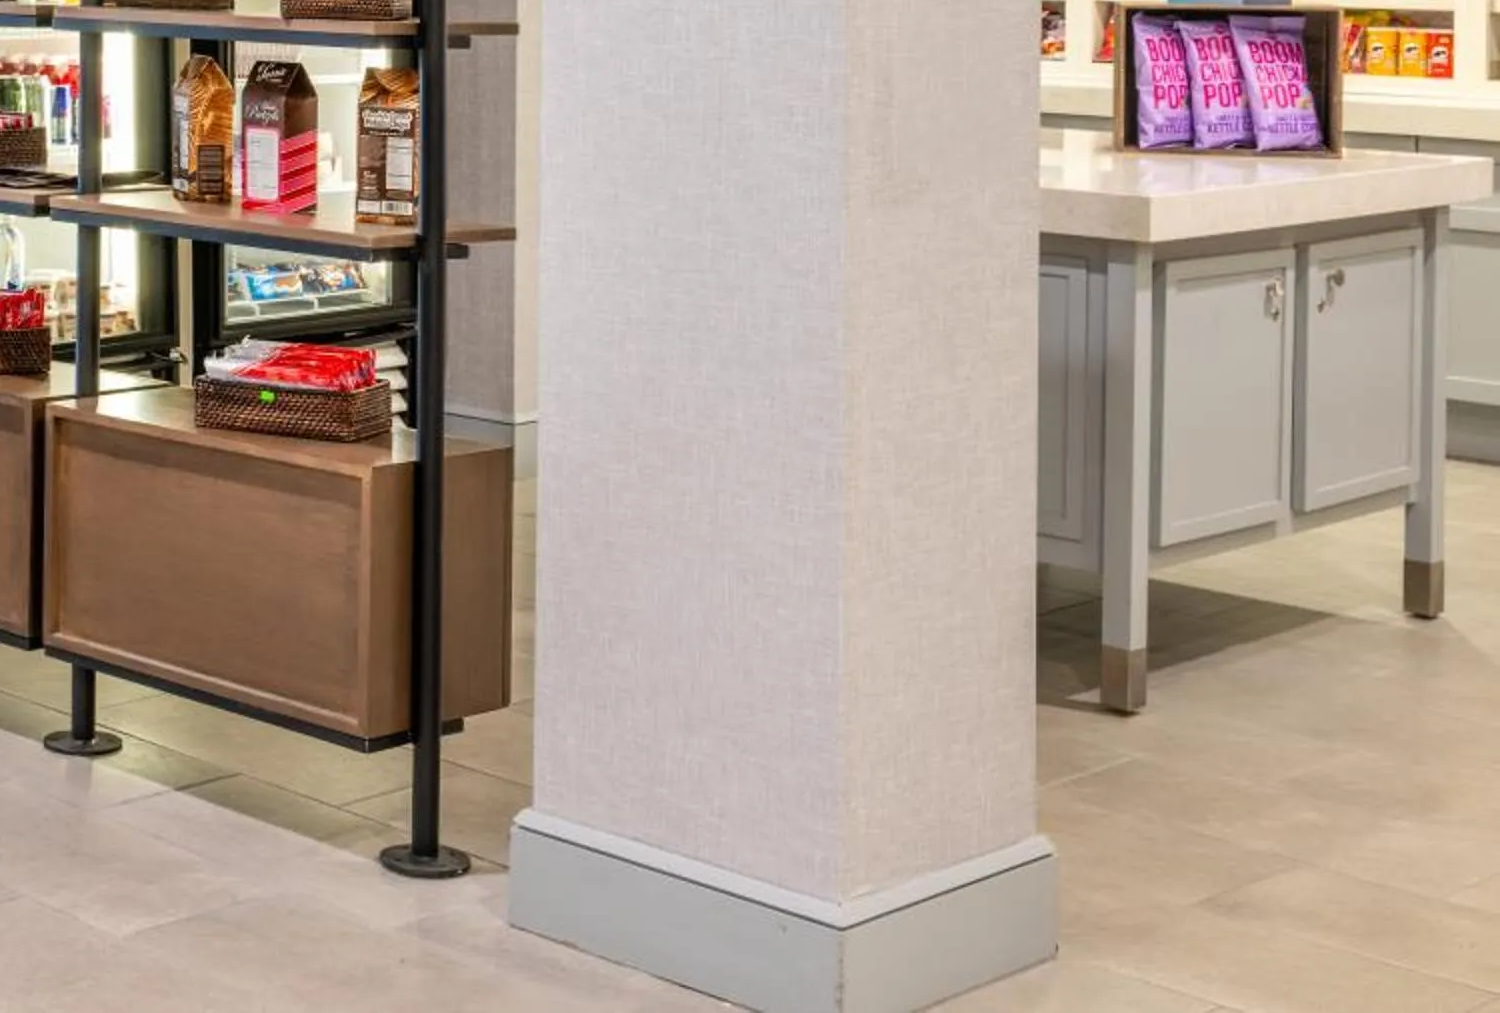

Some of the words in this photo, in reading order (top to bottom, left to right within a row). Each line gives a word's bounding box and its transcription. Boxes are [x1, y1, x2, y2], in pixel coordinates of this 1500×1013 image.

[1145, 37, 1185, 62] BOO
[1193, 35, 1238, 61] BOO
[1247, 40, 1304, 65] BOOM
[1203, 82, 1243, 109] POP
[1259, 83, 1300, 109] POP
